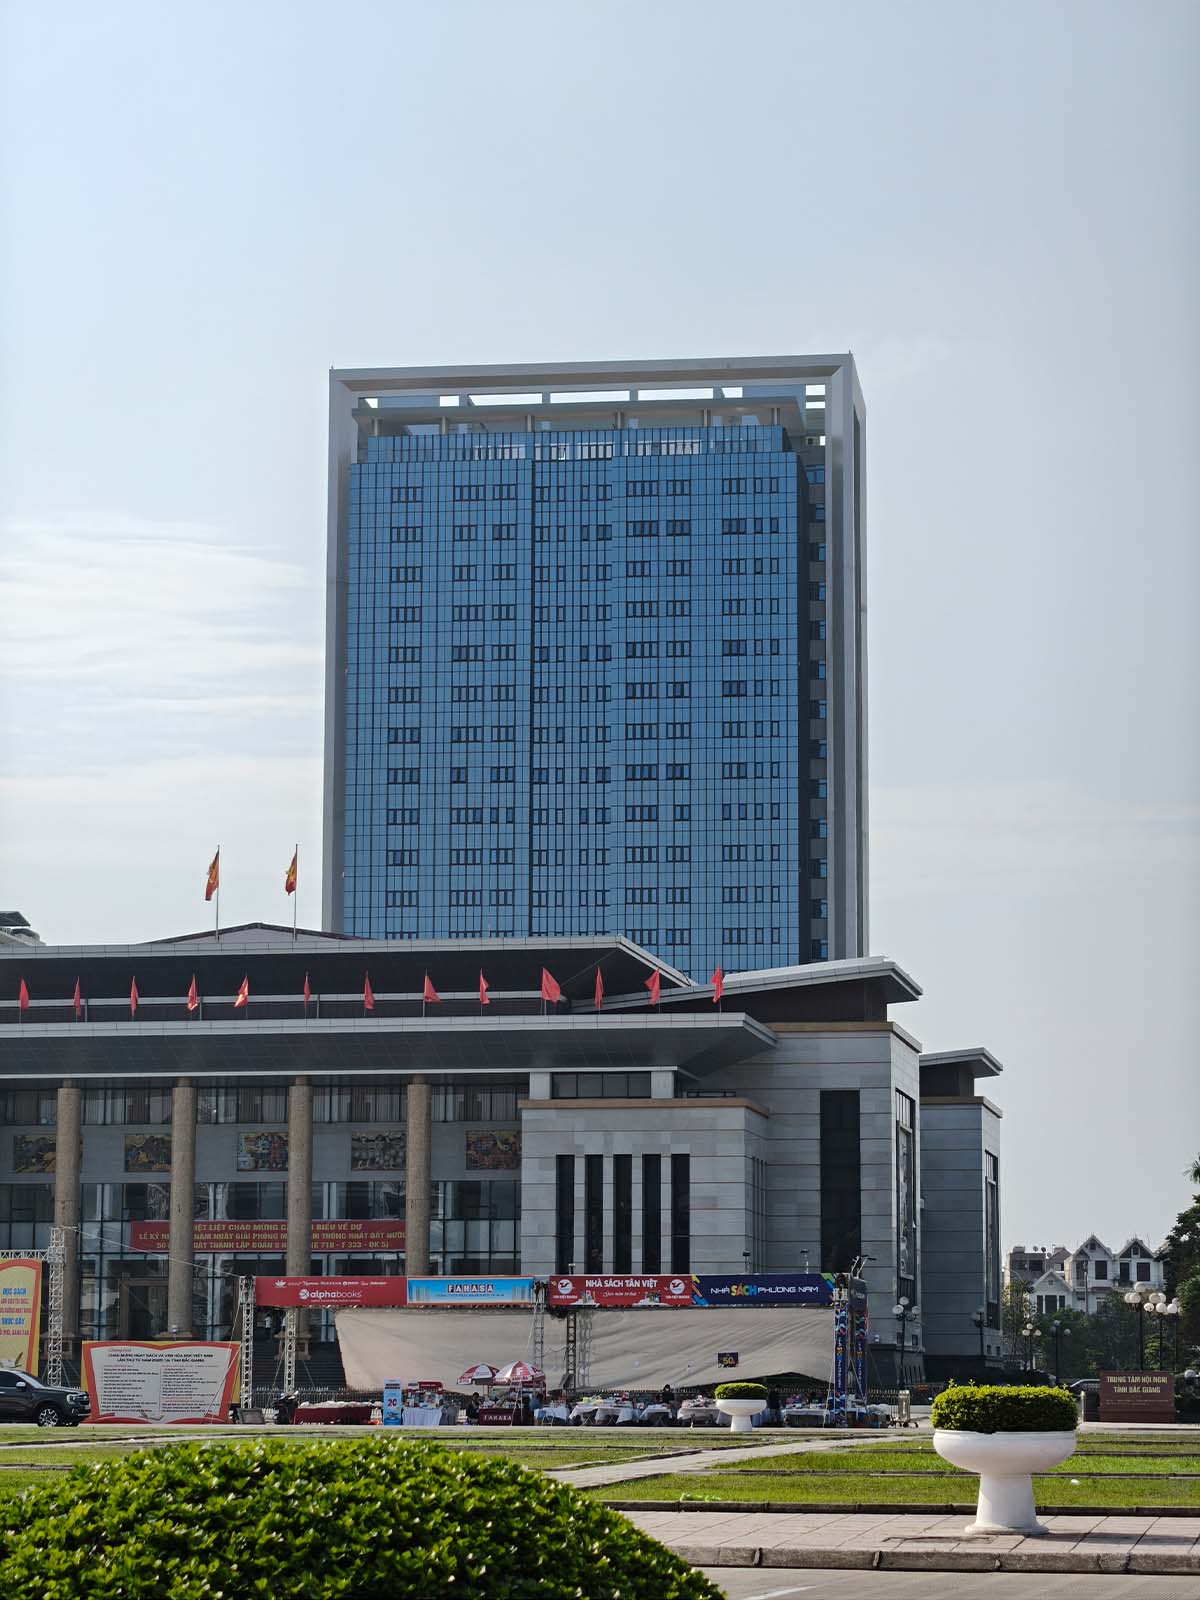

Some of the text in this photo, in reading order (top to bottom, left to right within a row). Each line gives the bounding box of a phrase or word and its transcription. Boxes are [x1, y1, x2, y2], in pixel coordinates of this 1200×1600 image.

[447, 1284, 494, 1293] FAHASA
[585, 1277, 658, 1289] NHÀ SÁCH TÂN VIỆT
[310, 1288, 362, 1299] alphabooks
[710, 1286, 730, 1294] NHÀ
[730, 1283, 757, 1296] SÁCH
[757, 1285, 796, 1293] PHƯƠNG
[1106, 1375, 1127, 1383] TRUNG
[1127, 1375, 1141, 1383] TÂM
[1141, 1375, 1152, 1384] HỘI
